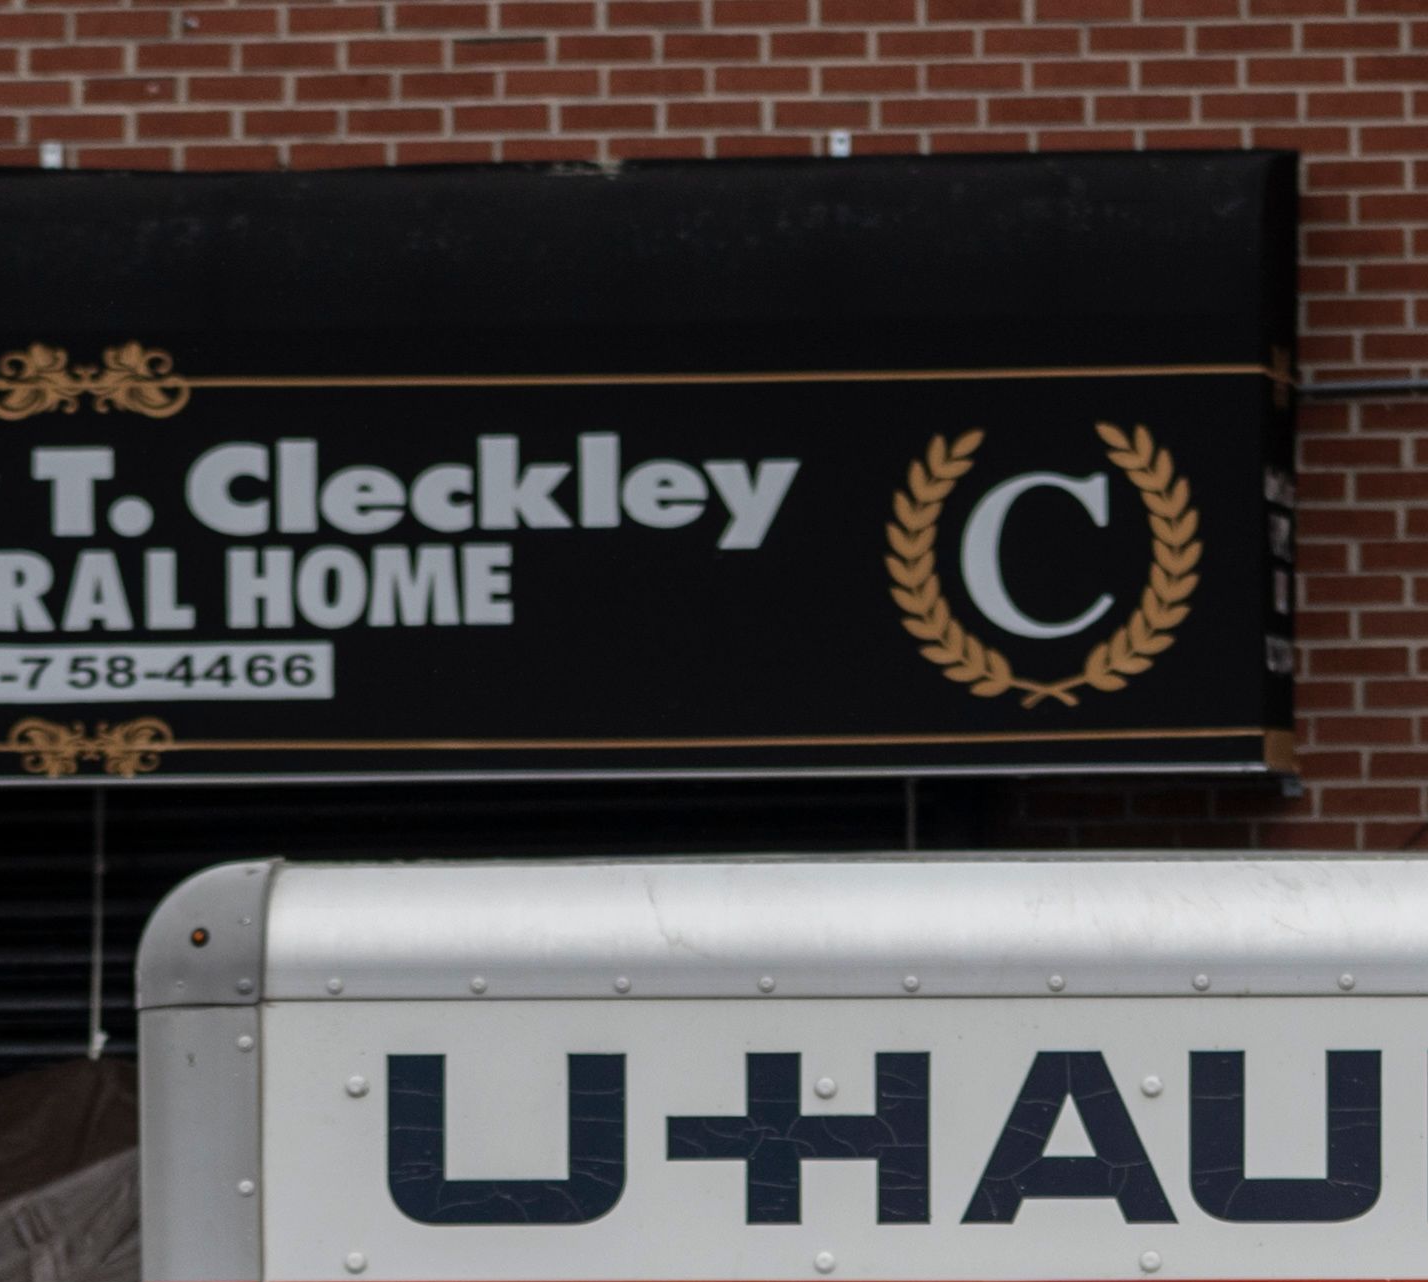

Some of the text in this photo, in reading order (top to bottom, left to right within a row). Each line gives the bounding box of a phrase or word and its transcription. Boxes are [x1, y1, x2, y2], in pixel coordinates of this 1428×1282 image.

[30, 445, 155, 538] T.
[185, 431, 801, 551] Cleckley
[225, 543, 515, 630] HOME
[960, 471, 1115, 641] C
